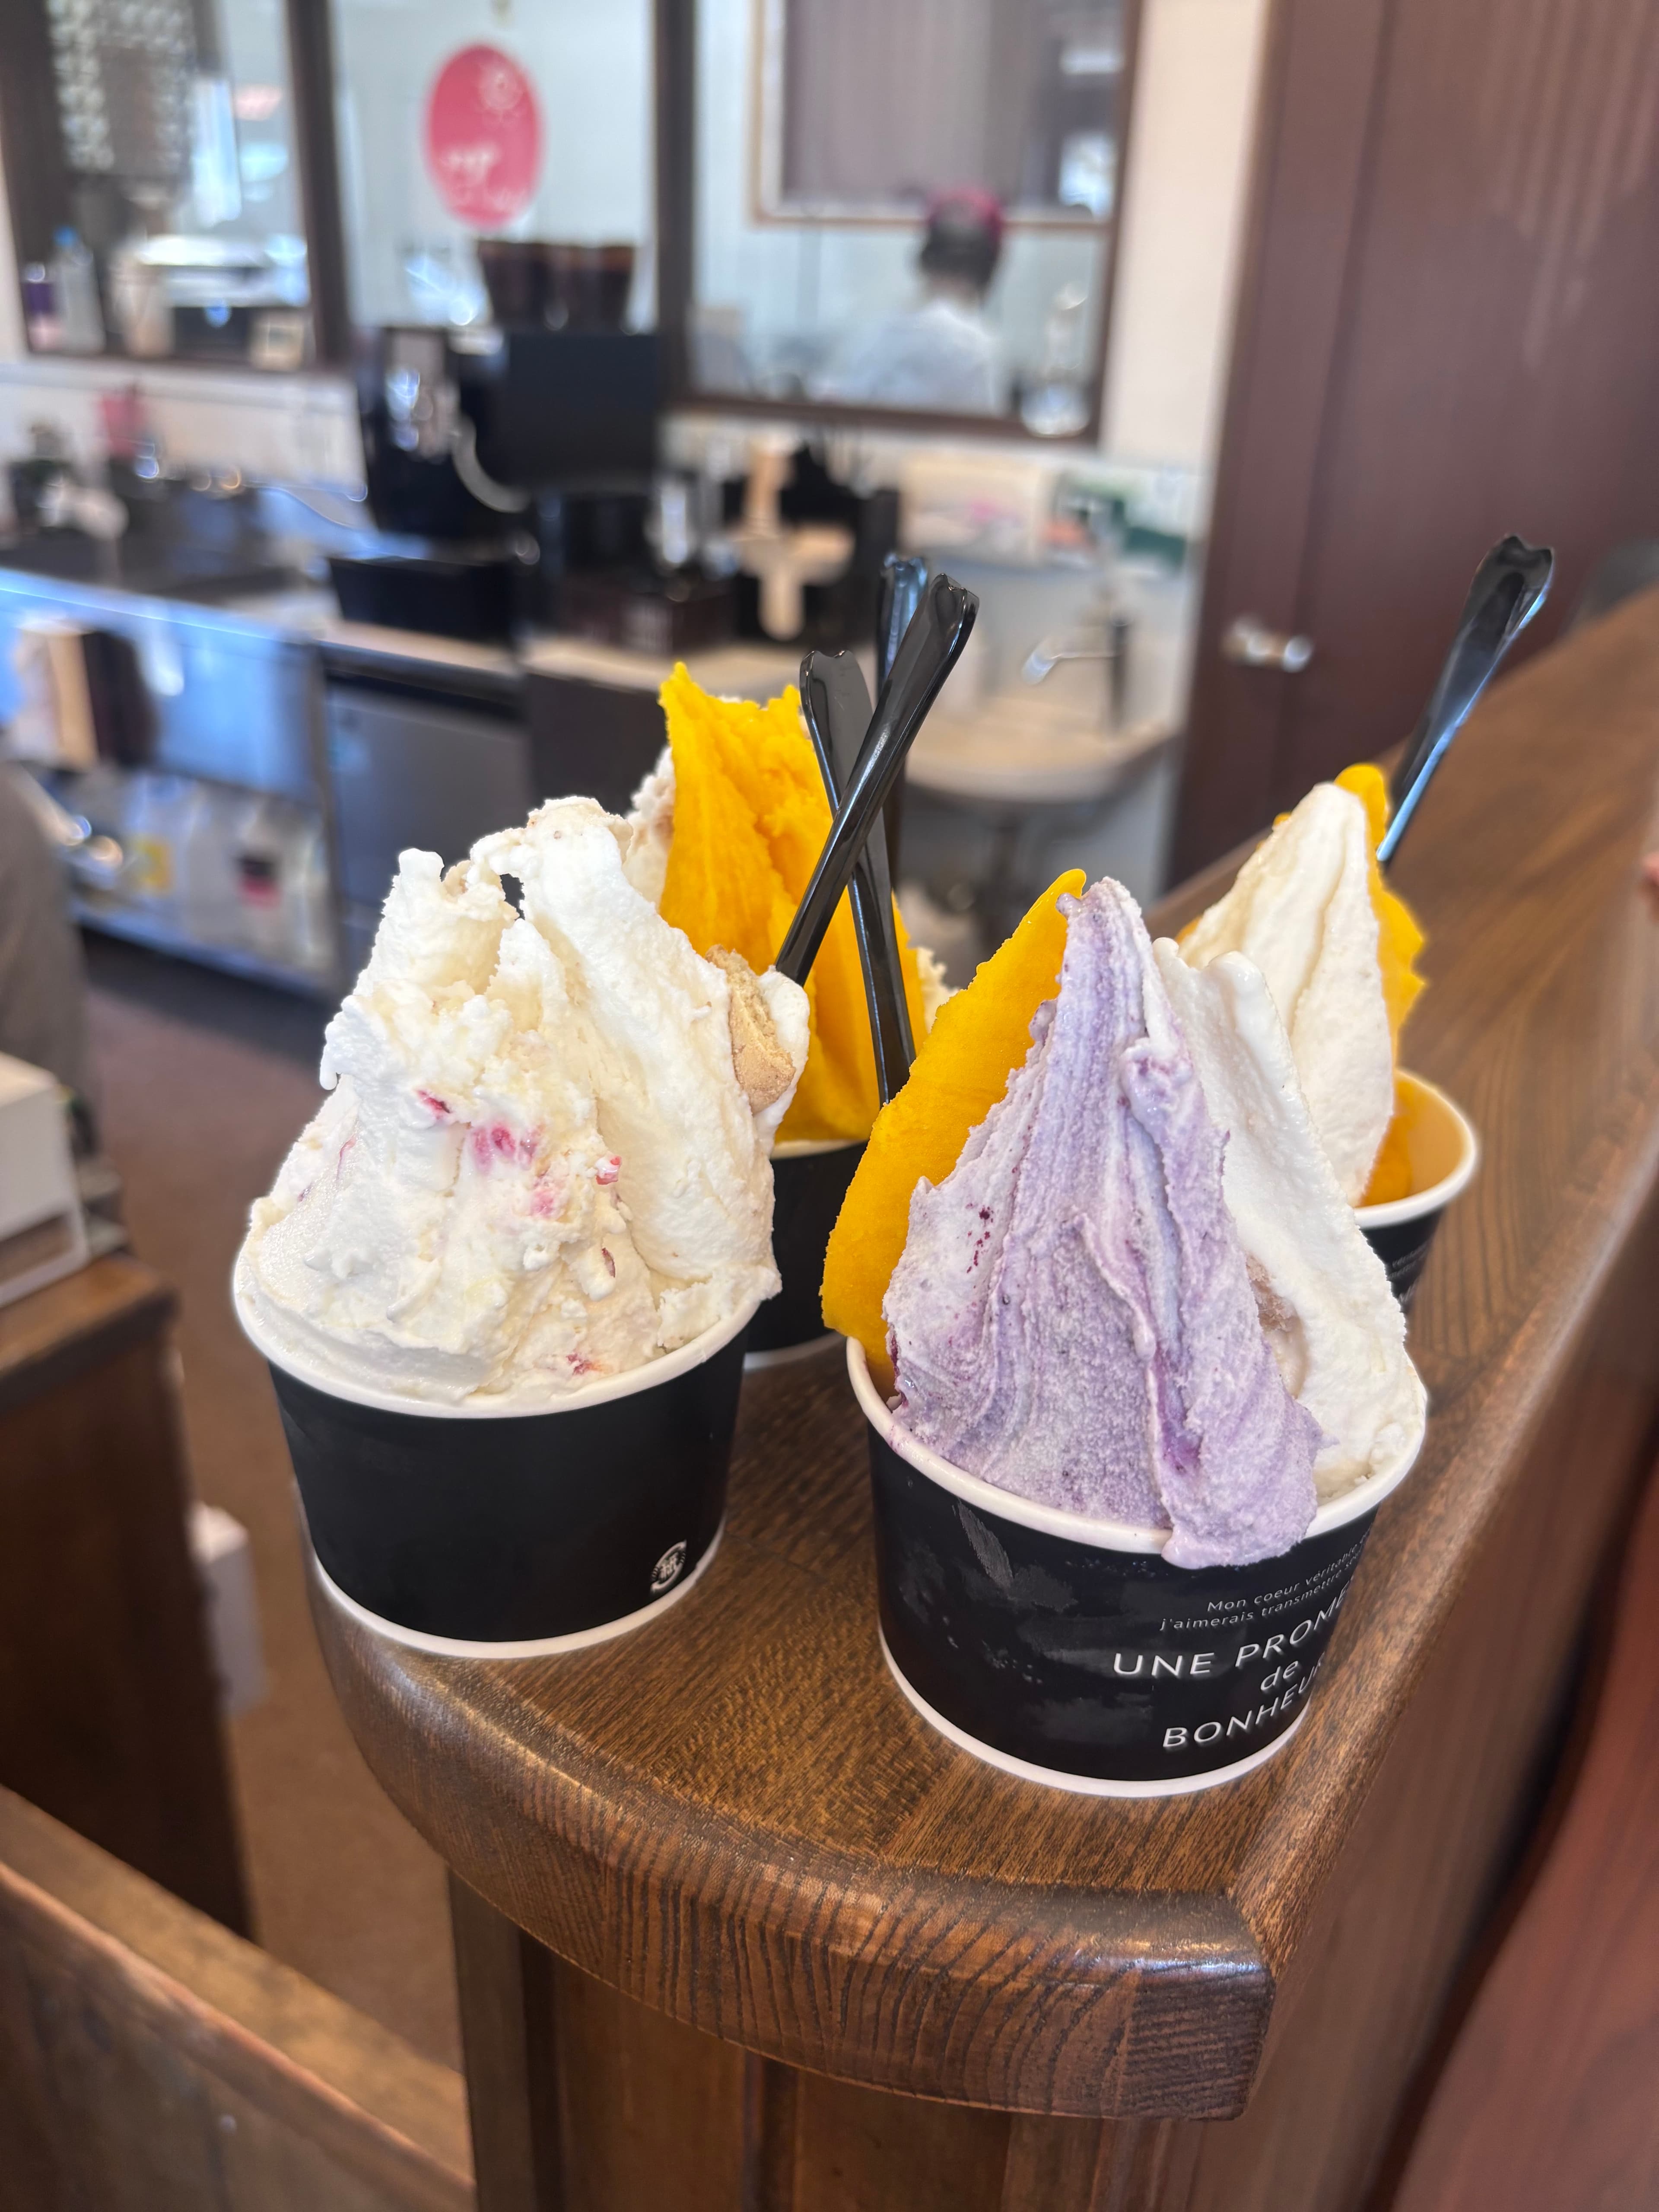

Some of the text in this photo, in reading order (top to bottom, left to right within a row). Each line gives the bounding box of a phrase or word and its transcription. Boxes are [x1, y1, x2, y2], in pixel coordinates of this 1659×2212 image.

[1160, 1569, 1341, 1631] j'aimerais transmettre
[1207, 1599, 1246, 1611] Mon
[1254, 1583, 1300, 1604] coeur
[1113, 1575, 1354, 1677] UNE PROME
[1260, 1660, 1298, 1691] de
